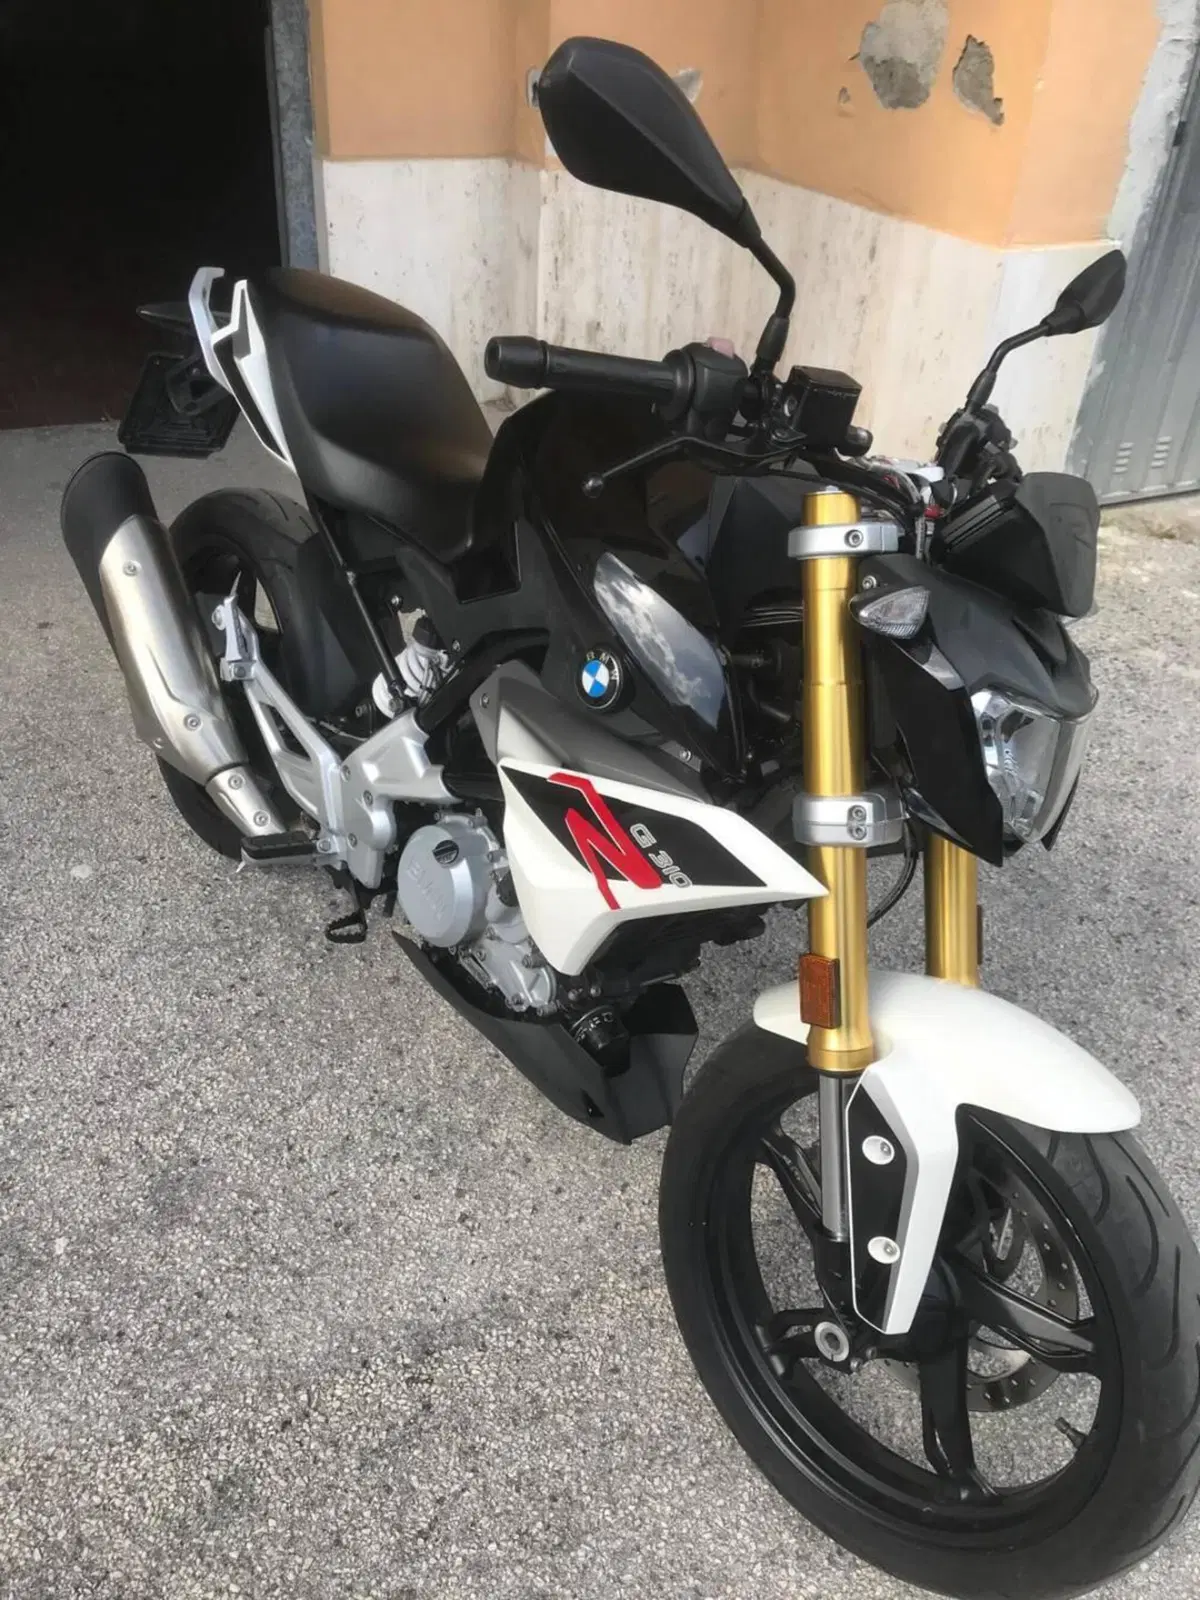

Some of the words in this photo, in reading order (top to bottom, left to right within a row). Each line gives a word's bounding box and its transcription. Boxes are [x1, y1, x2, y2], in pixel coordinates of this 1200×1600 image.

[586, 651, 619, 680] BMW
[630, 823, 658, 848] G
[648, 850, 692, 888] 310
